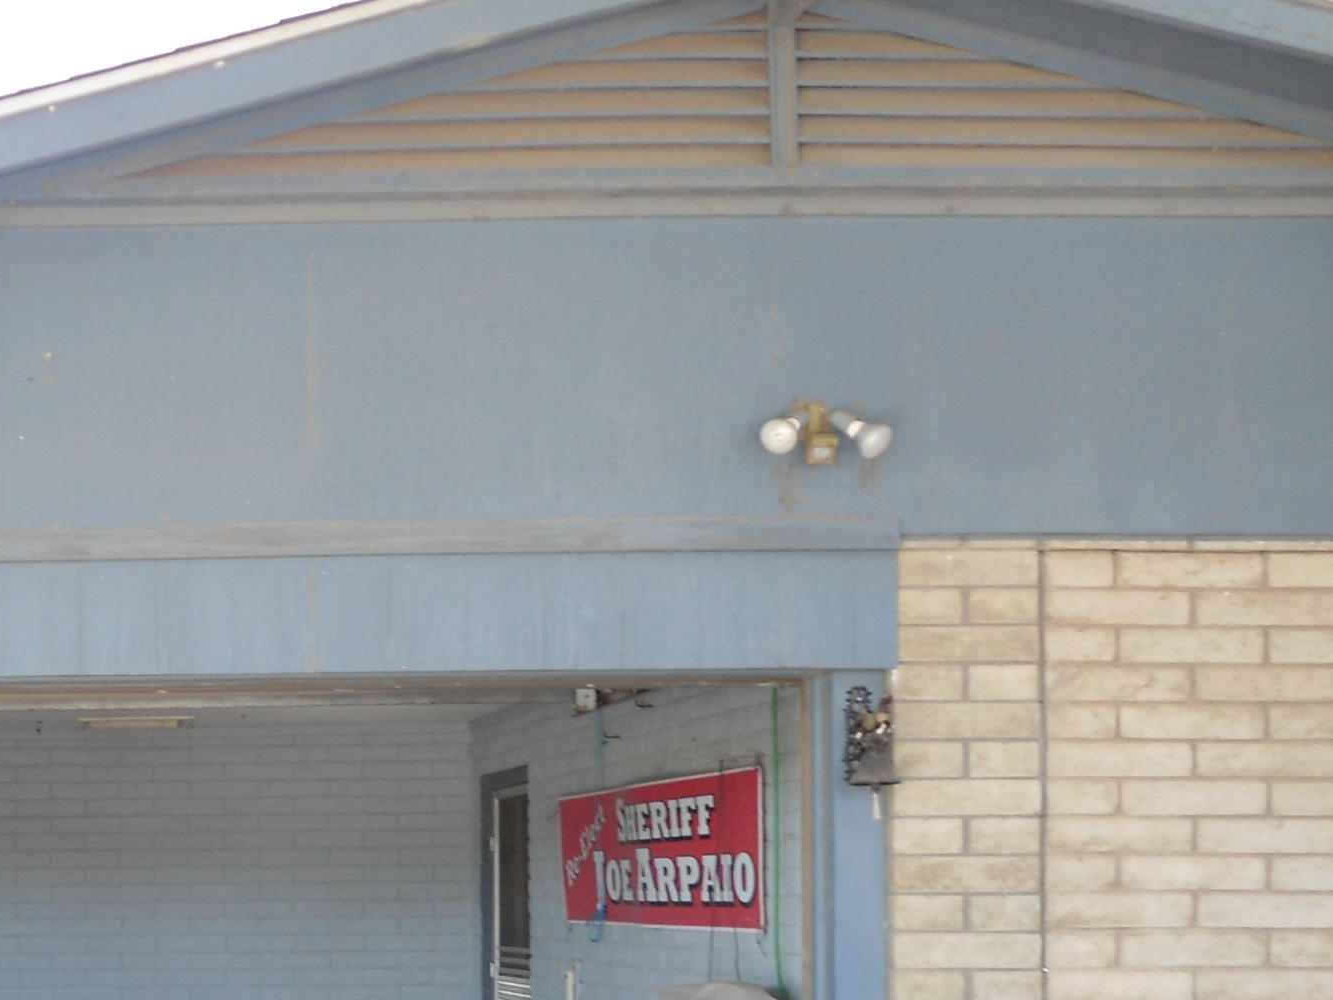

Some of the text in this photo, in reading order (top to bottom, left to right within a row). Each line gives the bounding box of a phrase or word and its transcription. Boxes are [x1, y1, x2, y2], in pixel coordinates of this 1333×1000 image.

[617, 795, 714, 842] SHERIFF
[593, 847, 756, 910] JOE ARPAIO
